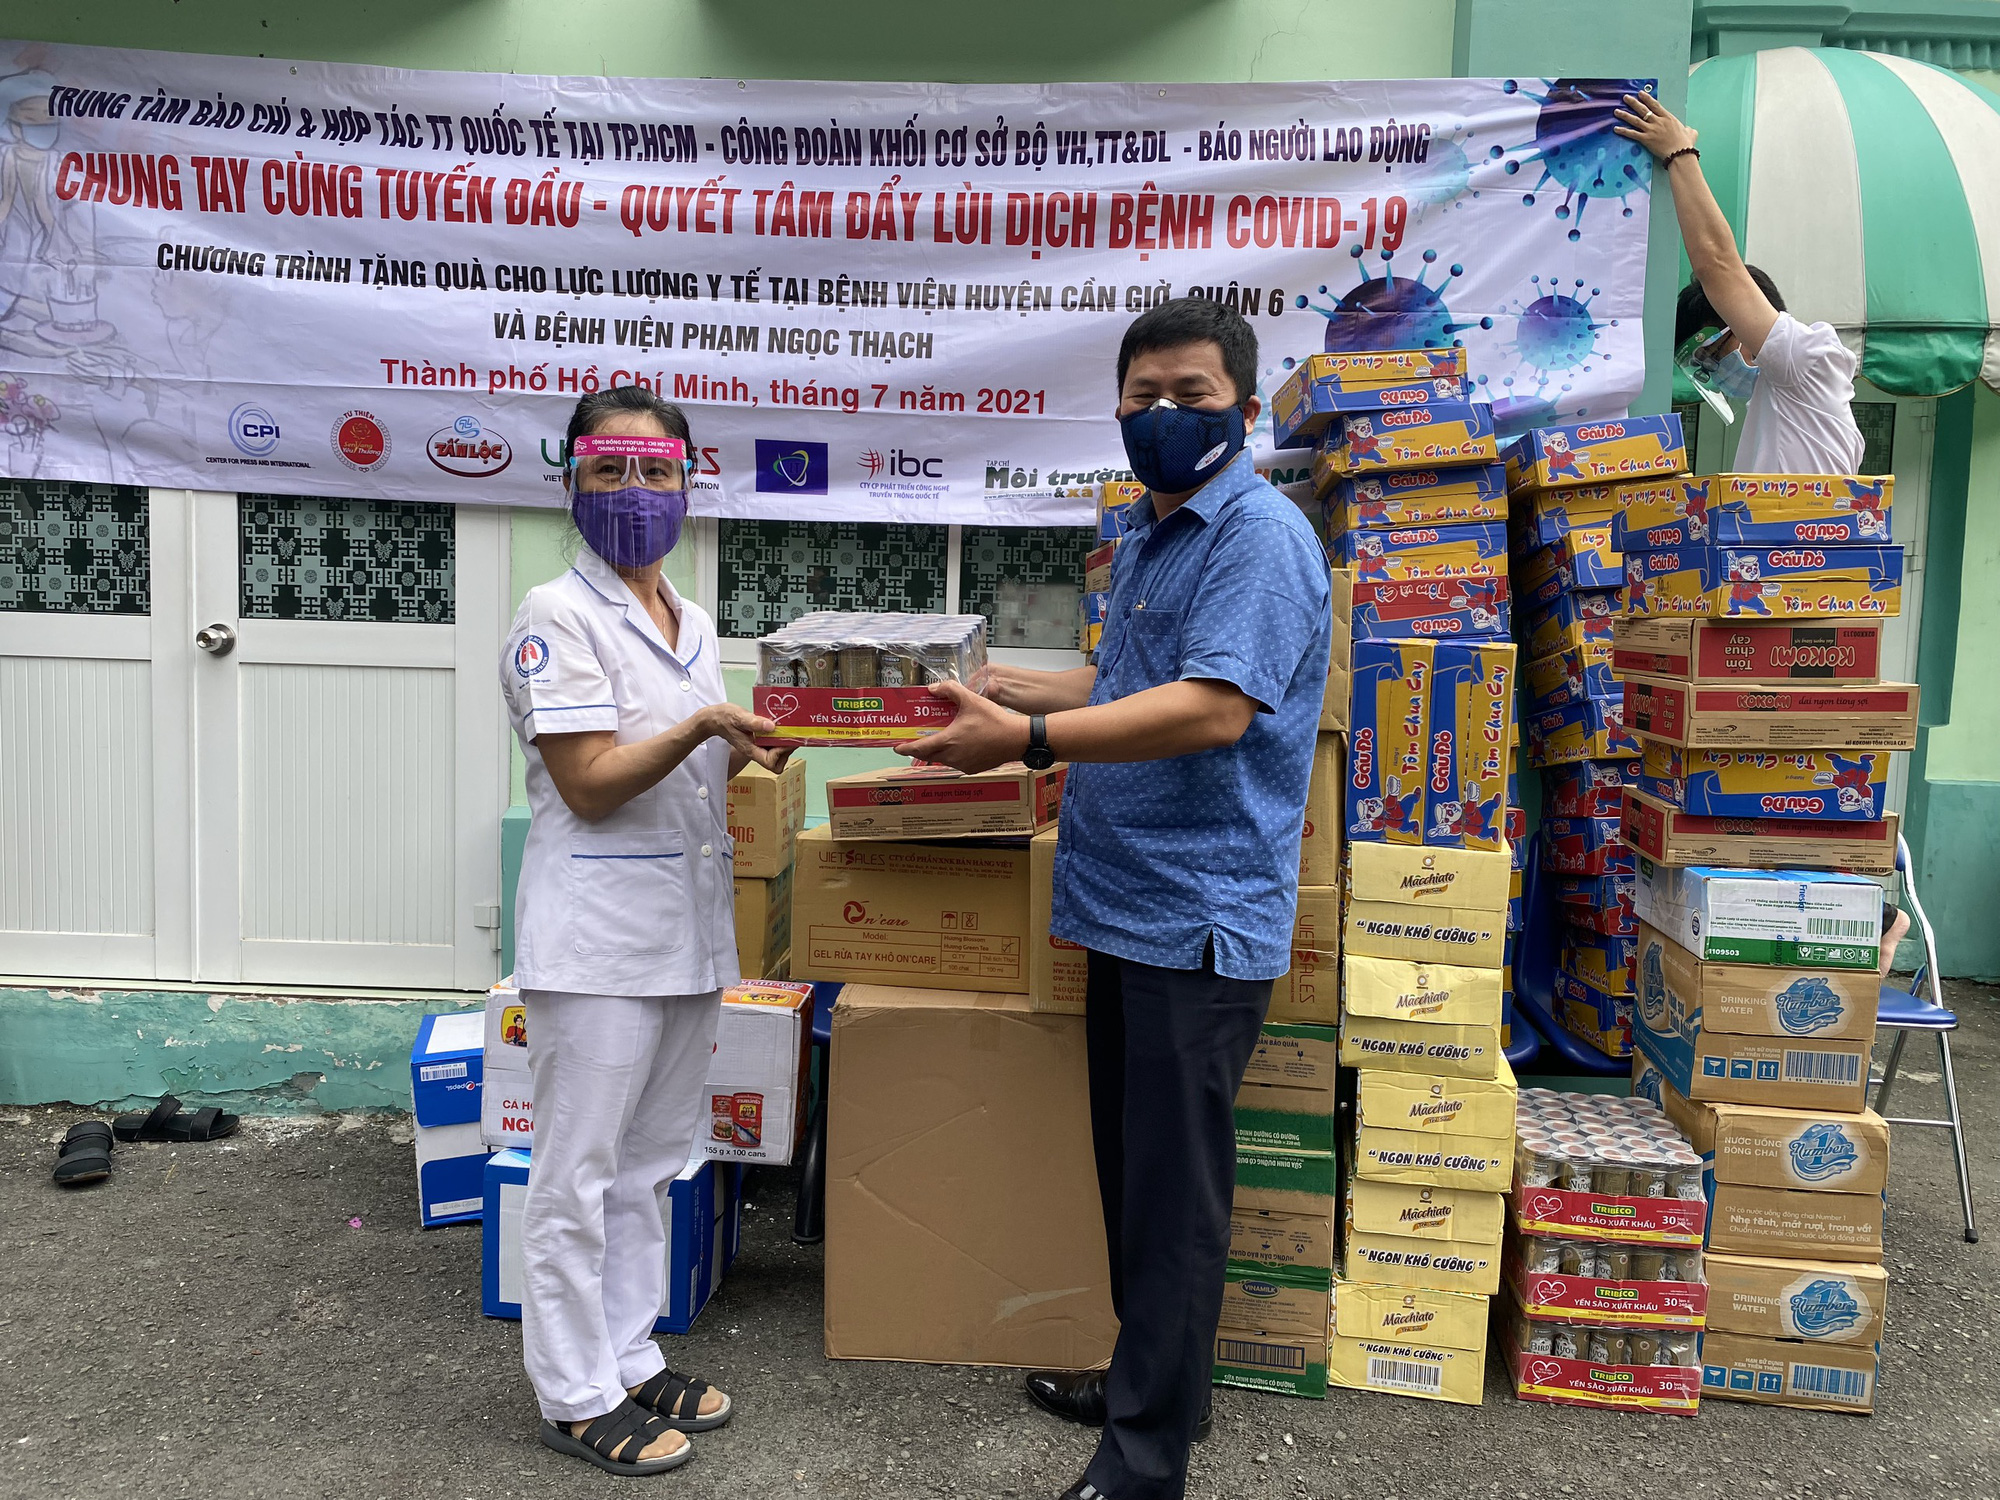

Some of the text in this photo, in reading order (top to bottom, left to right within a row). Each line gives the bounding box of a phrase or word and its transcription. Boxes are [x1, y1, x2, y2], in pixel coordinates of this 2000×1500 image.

[49, 85, 1431, 173] TRUNG TÂM BÁO CHÍ & HỢP TÁC TT QUỐC TẾ TẠI TP.HCM CÔNG ĐOÀN KHỐI CƠ SỞ BỘ VH,TT&DL BÁO NGƯỜI LAO ĐỘNG
[55, 150, 1408, 262] CHUNG TAY CÙNG TUYẾN ĐẦU QUYẾT TÂM ĐẨY LÙI DỊCH BỆNH COVID-19
[156, 243, 266, 277] CHƯƠNG
[274, 250, 351, 284] TRÌNH
[359, 253, 426, 291] TẶNG
[435, 257, 487, 291] QUÀ
[494, 264, 547, 293] CHO
[555, 266, 604, 301] LỰC
[611, 268, 698, 304] LƯỢNG
[706, 274, 722, 301] Y
[731, 266, 762, 304] TẾ
[769, 277, 809, 311] TẠI
[817, 273, 888, 313] BỆNH
[897, 277, 957, 316] VIỆN
[965, 280, 1052, 318] HUYỆN
[1061, 277, 1117, 313] CẦN
[1268, 288, 1284, 317] 6
[493, 308, 934, 364] VÀ BỆNH VIỆN PHẠM NGỌC THẠCH
[380, 358, 476, 388] Thành
[488, 362, 549, 394] phố
[557, 364, 599, 394] Hồ
[674, 373, 758, 407] Minh,
[769, 379, 859, 414] tháng
[871, 384, 889, 408] 7
[900, 384, 965, 412] năm
[977, 388, 1045, 415] 2021
[242, 423, 281, 439] CPI
[468, 440, 503, 465] LỘC
[1393, 442, 1486, 461] Tôm Chua Cay
[890, 448, 943, 478] ibc
[1590, 455, 1678, 477] Tôm Chua Cay
[985, 467, 1141, 489] Môi trườn
[1781, 594, 1887, 614] Tôm Chua Cay
[1729, 634, 1751, 645] cay
[1724, 646, 1755, 657] chua
[1769, 645, 1856, 667] KOKOMI
[1726, 659, 1753, 671] Tôm
[837, 699, 878, 709] TRIBECO
[1736, 694, 1793, 709] KOKOMI
[1812, 698, 1834, 710] ngon
[810, 712, 907, 724] YẾN SÀO XUẤT KHẨU
[914, 706, 930, 717] 30
[1401, 659, 1429, 775] Tôm Chua Cay
[862, 931, 889, 941] Model:
[1367, 921, 1477, 944] NGON KHÓ CƯỠNG
[814, 947, 937, 965] GEL RỬA TAY KHÔ ON'CARE
[1721, 996, 1767, 1006] DRINKING
[1721, 1006, 1754, 1015] WATER
[502, 1099, 518, 1109] CÁ
[1725, 1136, 1782, 1148] NƯỚC UỐNG
[704, 1146, 718, 1154] 155
[733, 1149, 746, 1157] 100
[1724, 1147, 1778, 1158] ĐÓNG CHAI
[1595, 1205, 1632, 1215] TRIBECO
[1828, 1223, 1855, 1234] trong
[1245, 1284, 1276, 1293] VINAMILK
